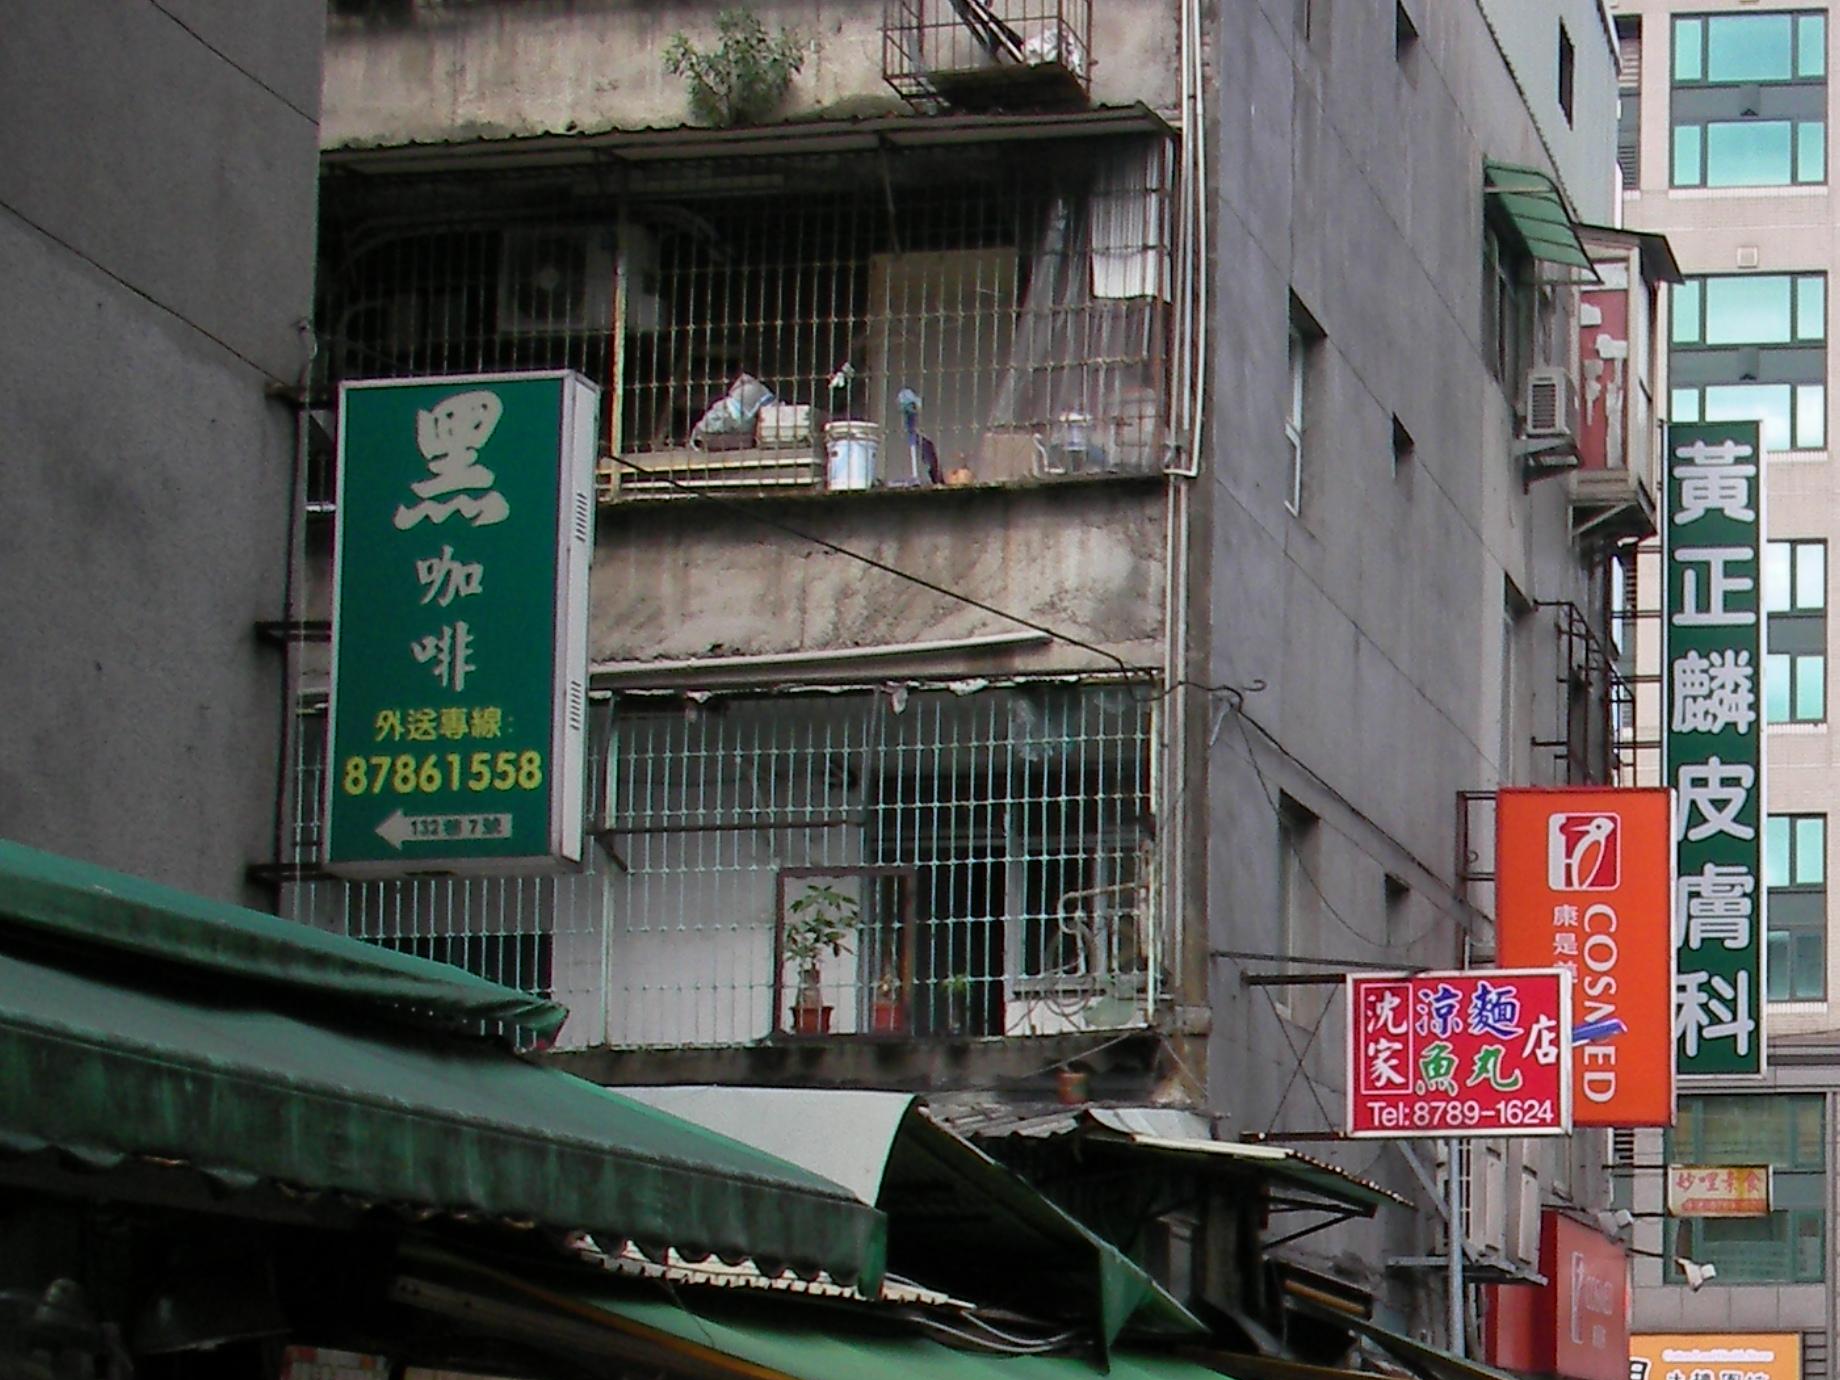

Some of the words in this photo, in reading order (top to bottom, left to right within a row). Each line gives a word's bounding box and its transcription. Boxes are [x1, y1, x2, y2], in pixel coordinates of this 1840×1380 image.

[394, 390, 509, 692] 黑咖啡
[344, 751, 543, 796] 87861558
[1671, 440, 1757, 1057] 黃正麟皮膚科
[1366, 990, 1407, 1087] 沈家
[1414, 1042, 1523, 1097] 魚丸
[1522, 1013, 1560, 1065] 店
